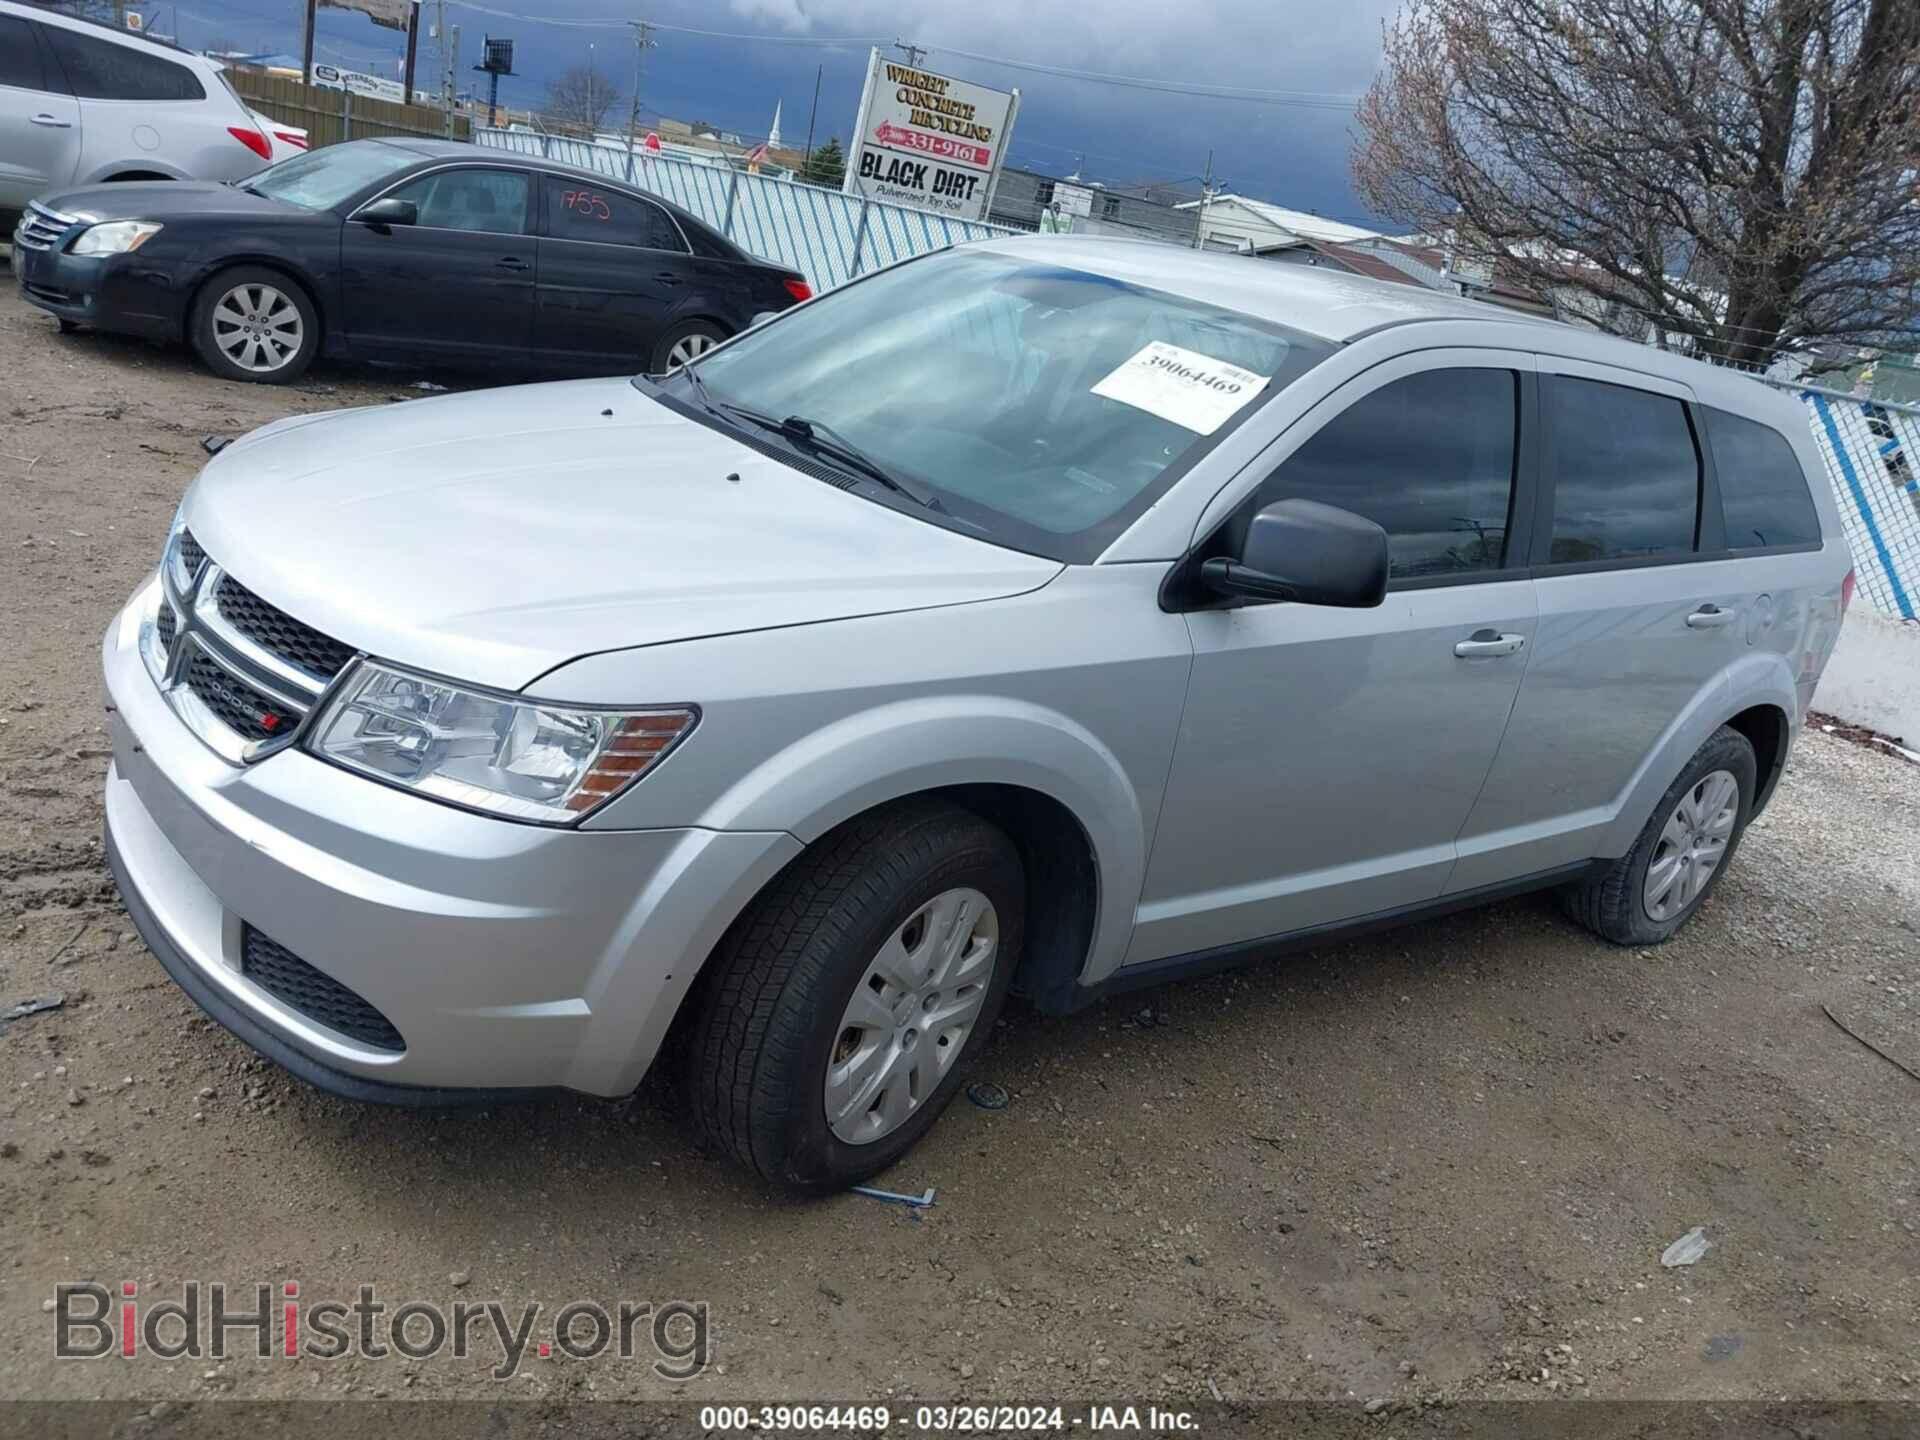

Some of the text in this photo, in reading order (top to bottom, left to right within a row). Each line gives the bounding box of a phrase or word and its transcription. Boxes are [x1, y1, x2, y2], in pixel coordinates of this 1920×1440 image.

[886, 64, 949, 95] WRIGHT
[896, 87, 976, 120] CONCRETE
[909, 109, 992, 142] RECYCLING
[905, 132, 977, 161] 331-9161
[859, 151, 979, 200] BLACK DIRT
[875, 184, 963, 210] Pulverized Top Soil
[1142, 355, 1241, 394] 39064469
[212, 681, 268, 724] DODGE
